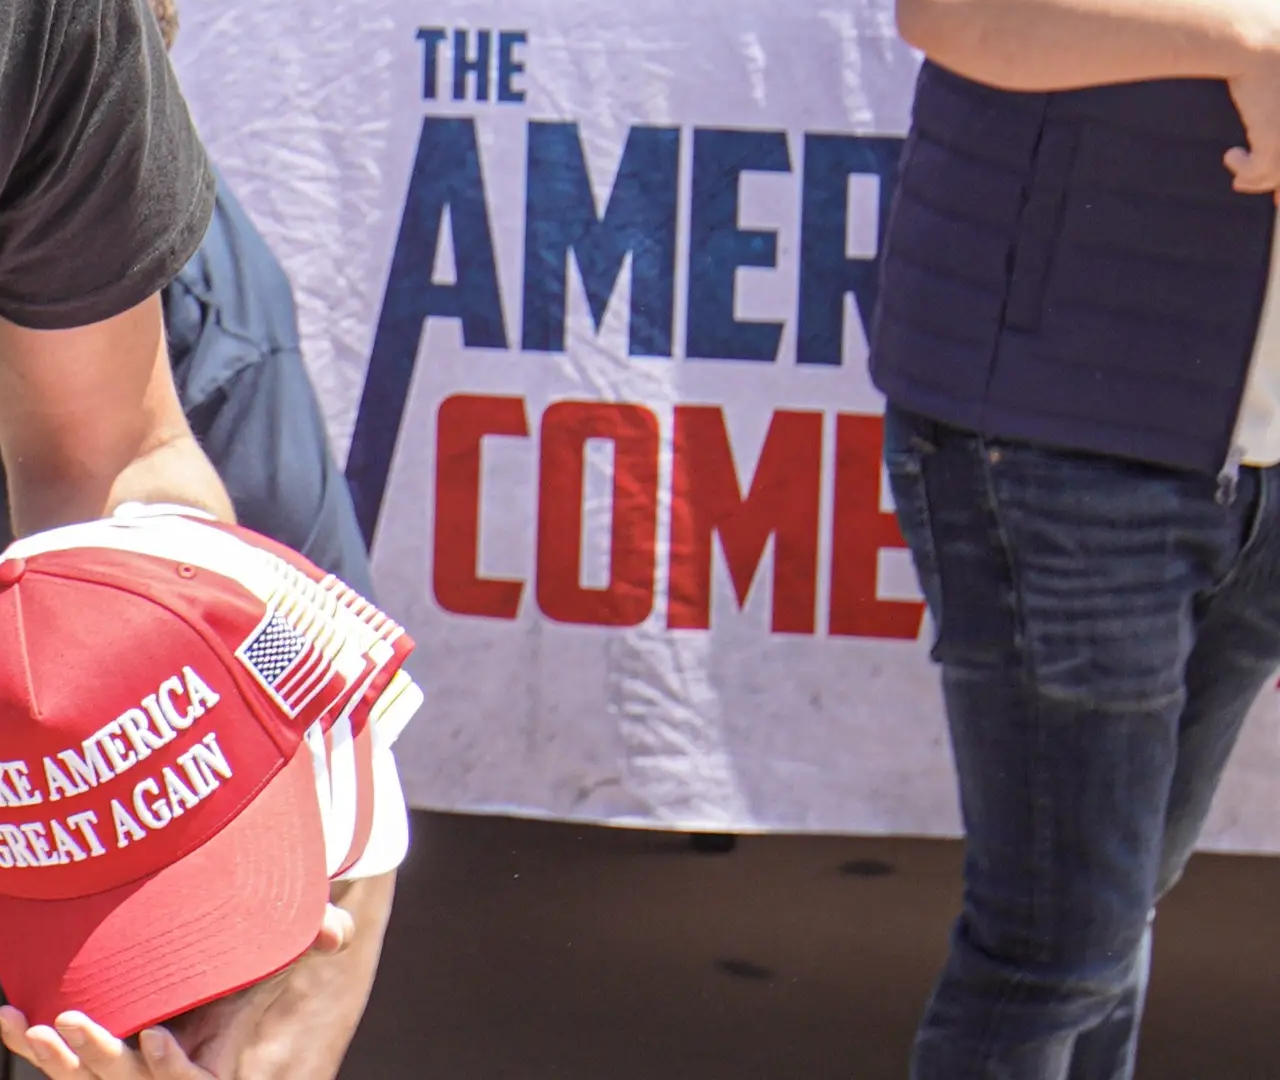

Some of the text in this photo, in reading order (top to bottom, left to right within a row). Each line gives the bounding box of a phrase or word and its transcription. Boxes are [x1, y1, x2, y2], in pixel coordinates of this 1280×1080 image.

[416, 27, 528, 103] THE
[42, 665, 221, 802] AMERICA
[110, 732, 234, 849] AGAIN
